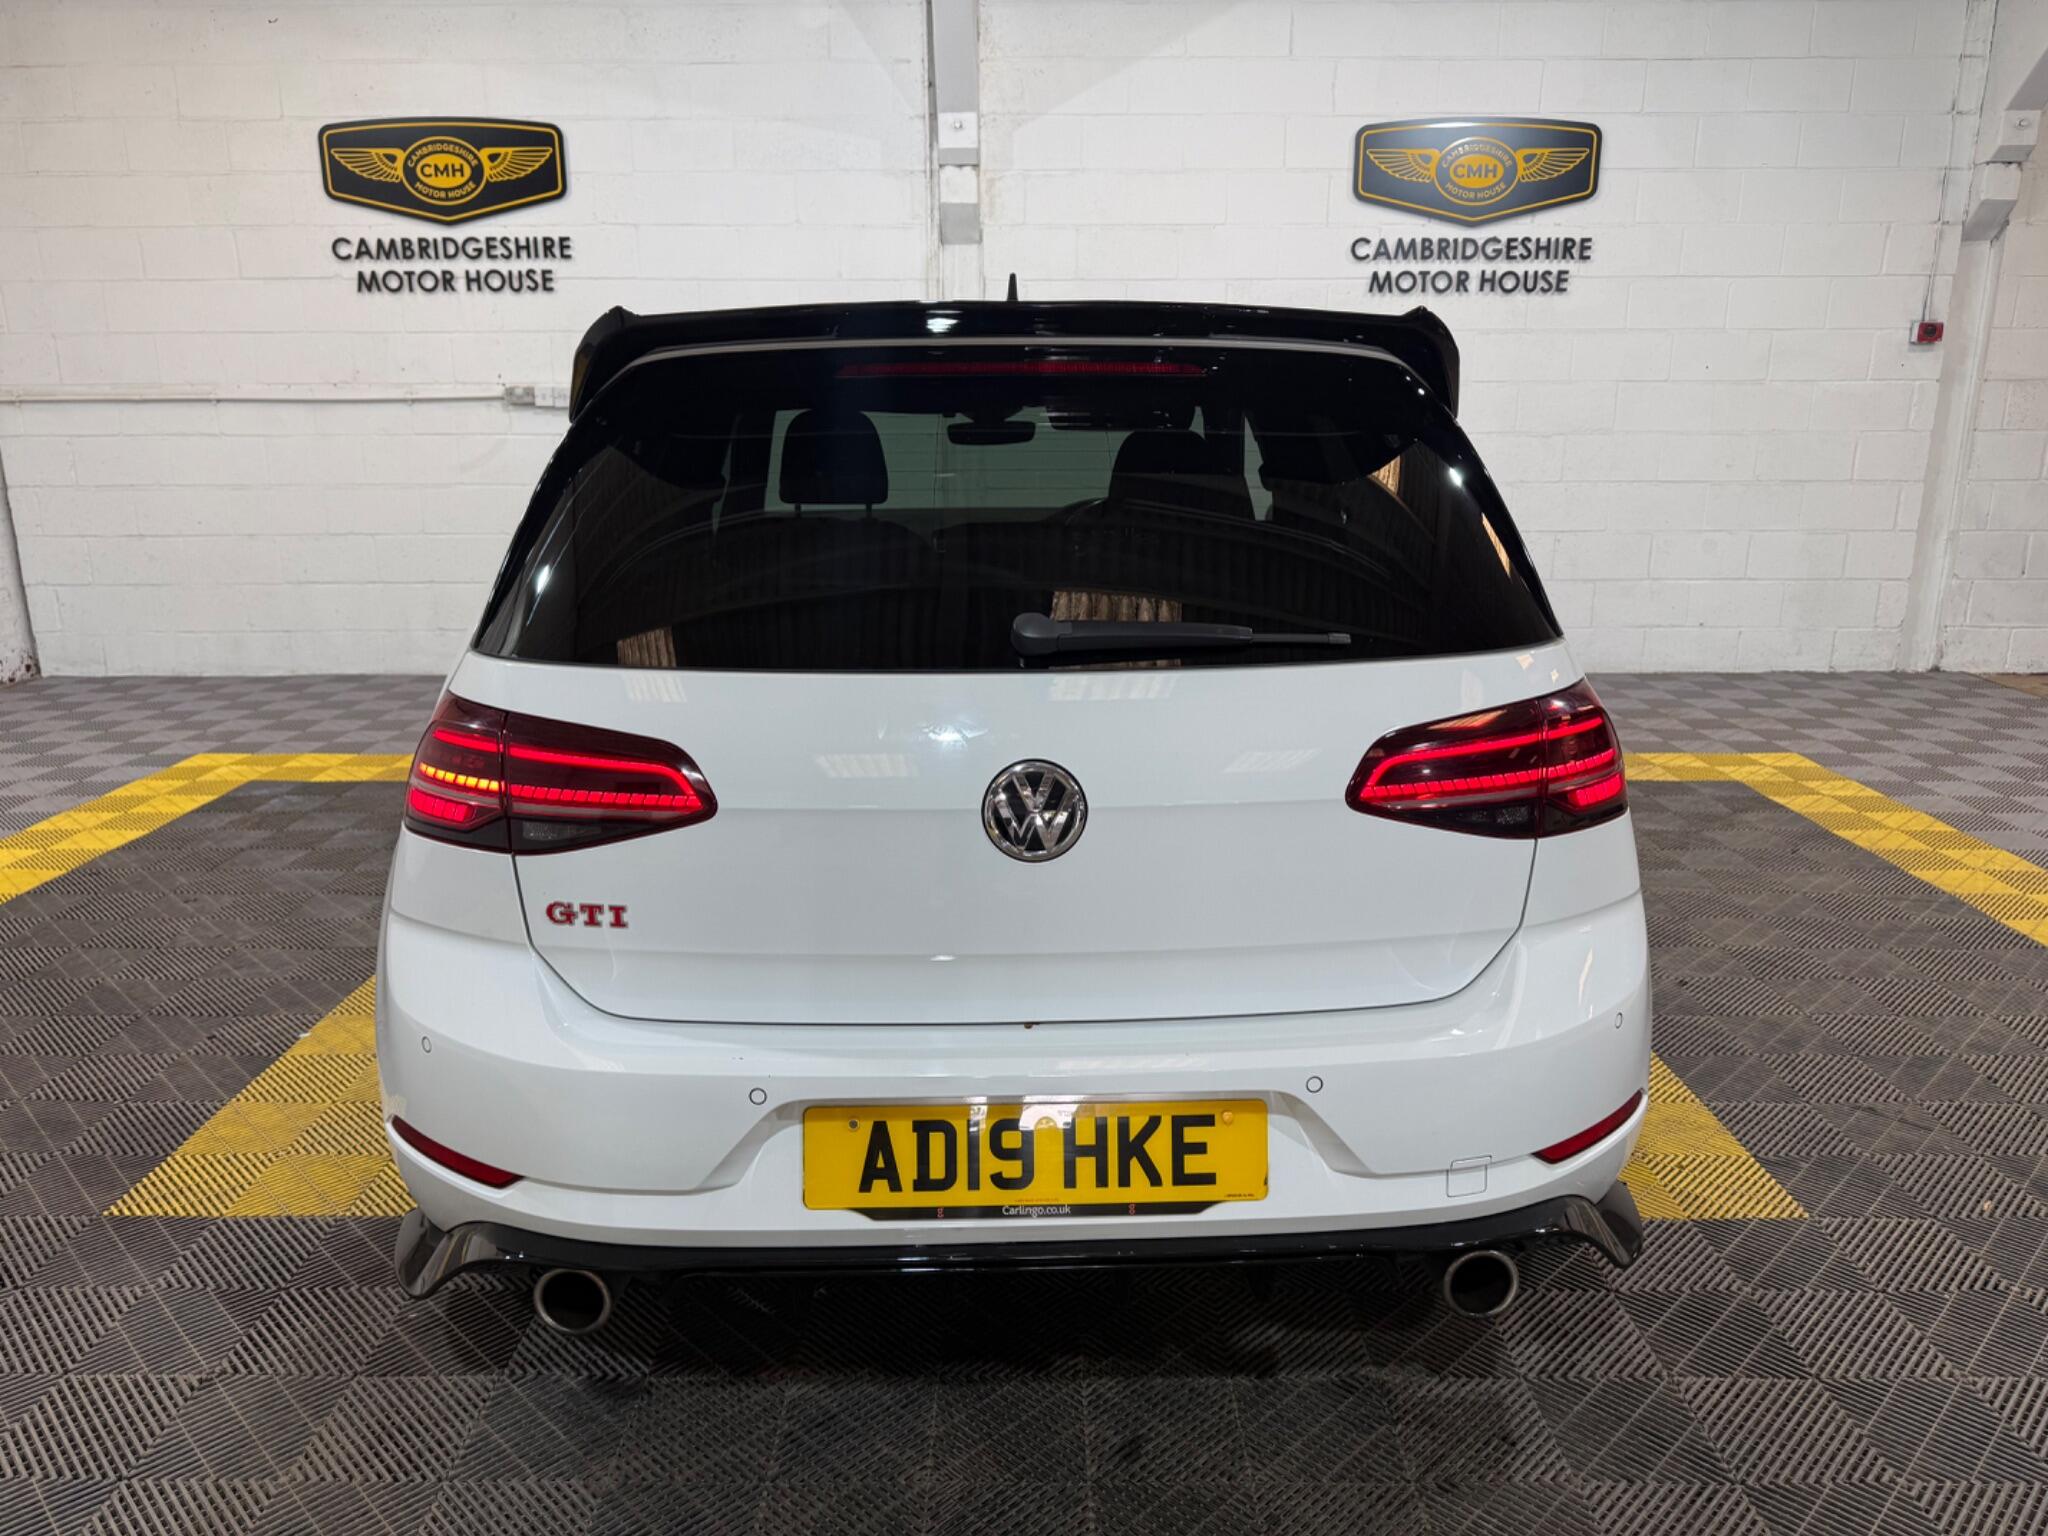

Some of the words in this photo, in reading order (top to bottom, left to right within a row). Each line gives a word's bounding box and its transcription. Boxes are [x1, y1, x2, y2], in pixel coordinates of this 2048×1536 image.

[408, 143, 479, 168] CAMBRIDGESHIRE
[420, 162, 465, 178] CMH
[1453, 163, 1498, 179] CMH
[414, 181, 447, 199] MOTOR
[447, 180, 477, 199] HOUSE
[1445, 182, 1473, 199] MOTOR
[1476, 181, 1506, 199] HOUSE
[331, 236, 572, 261] CAMBRIDGESHIRE
[1350, 236, 1592, 262] CAMBRIDGESHIRE
[357, 269, 456, 293] MOTOR
[465, 269, 555, 293] HOUSE
[1368, 270, 1470, 294] MOTOR
[1479, 269, 1569, 293] HOUSE
[545, 901, 629, 929] GTI
[858, 1118, 1035, 1193] AD19
[1062, 1114, 1217, 1190] HKE
[1002, 1204, 1071, 1218] Carlingo.co.uk
